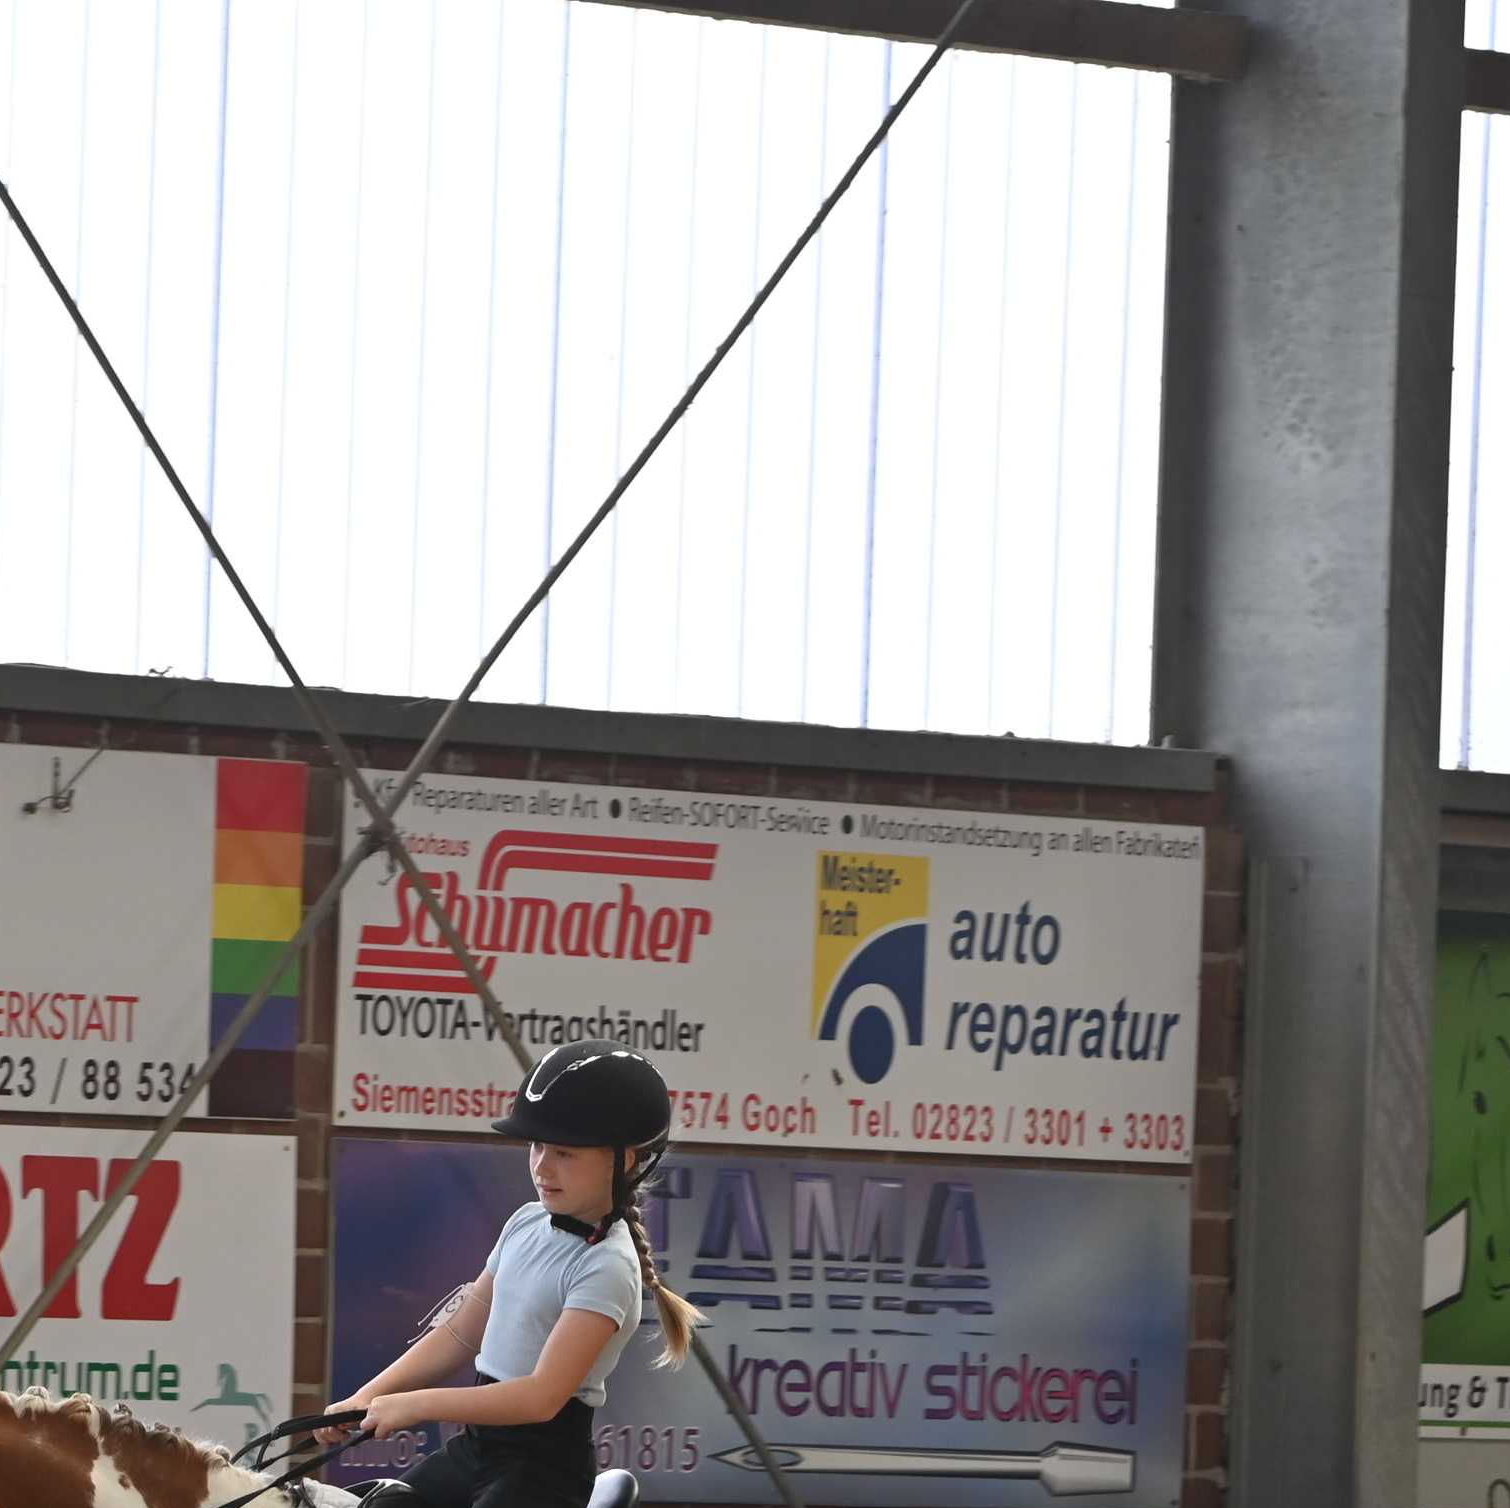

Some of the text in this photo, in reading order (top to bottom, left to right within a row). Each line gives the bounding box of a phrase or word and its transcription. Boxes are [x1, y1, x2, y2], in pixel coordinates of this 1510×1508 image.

[528, 788, 566, 816] aller
[569, 793, 599, 819] Art
[629, 796, 831, 836] Reifen-SOFORT-Service
[860, 813, 1043, 857] Motorinstandsetzung
[1047, 836, 1068, 852] an
[1071, 828, 1112, 856] allen
[1114, 830, 1202, 860] Fabrikaten
[820, 854, 902, 895] Meister-
[360, 868, 712, 964] Schumacher
[819, 900, 859, 938] haft
[949, 902, 1061, 966] auto
[945, 994, 1182, 1072] reparatur
[50, 1057, 67, 1104] /
[82, 1060, 120, 1101] 88
[742, 1092, 817, 1134] Goch
[848, 1098, 899, 1138] Tel.
[912, 1101, 995, 1143] 02823
[1024, 1107, 1087, 1146] 3301
[1123, 1111, 1186, 1152] 3303
[726, 1342, 1140, 1425] kreativ stickerei
[1468, 1375, 1487, 1409] &
